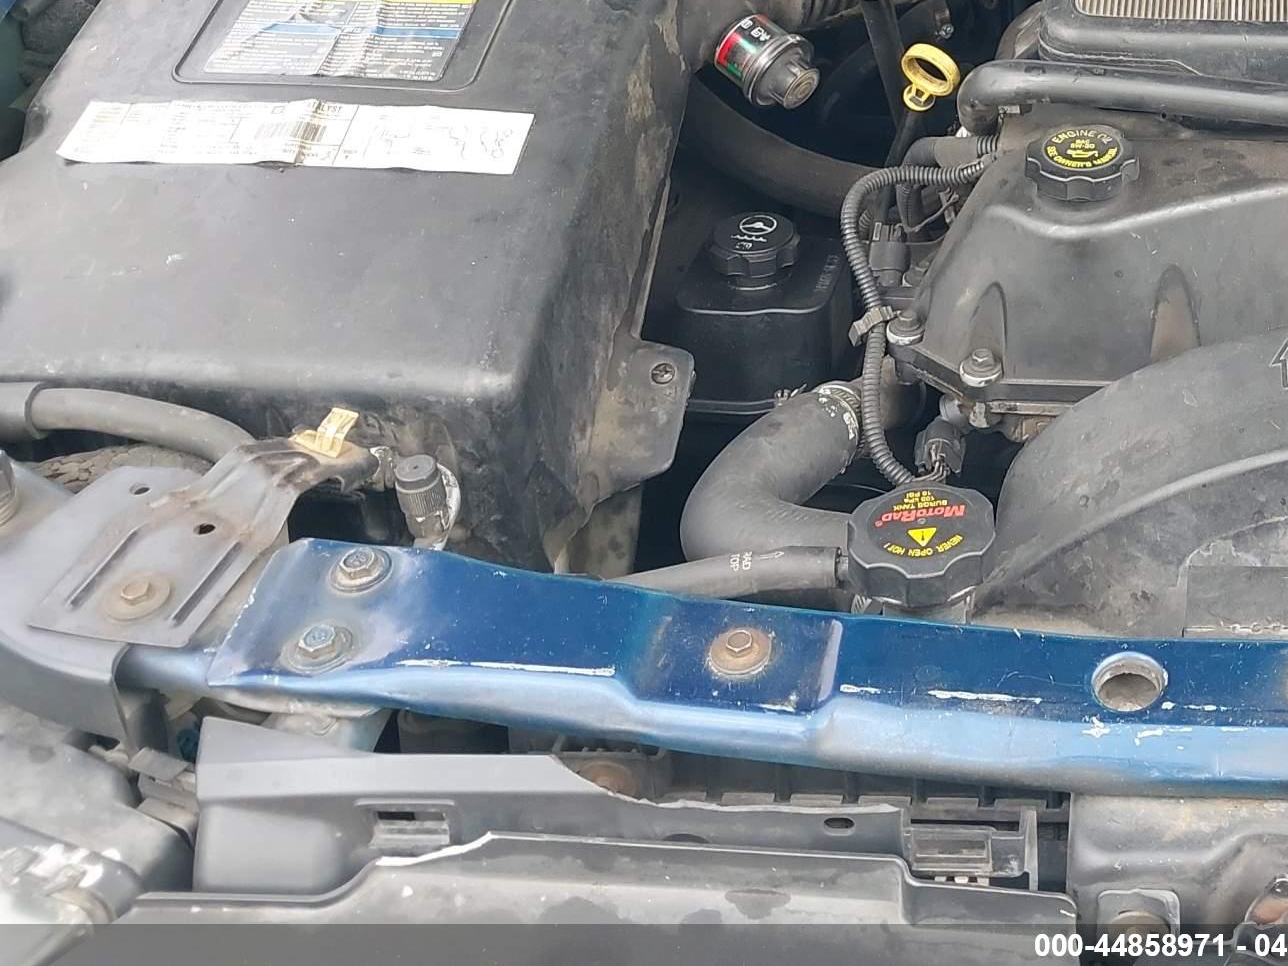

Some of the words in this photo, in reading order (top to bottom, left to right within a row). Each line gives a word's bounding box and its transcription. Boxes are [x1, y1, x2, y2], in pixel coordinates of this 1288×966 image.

[1051, 129, 1097, 144] ENGINE
[892, 503, 916, 512] TANK
[918, 499, 948, 508] SURGE
[935, 535, 963, 552] NEVER
[907, 547, 934, 557] OPEN
[730, 553, 740, 571] TOP
[742, 551, 753, 571] RAD
